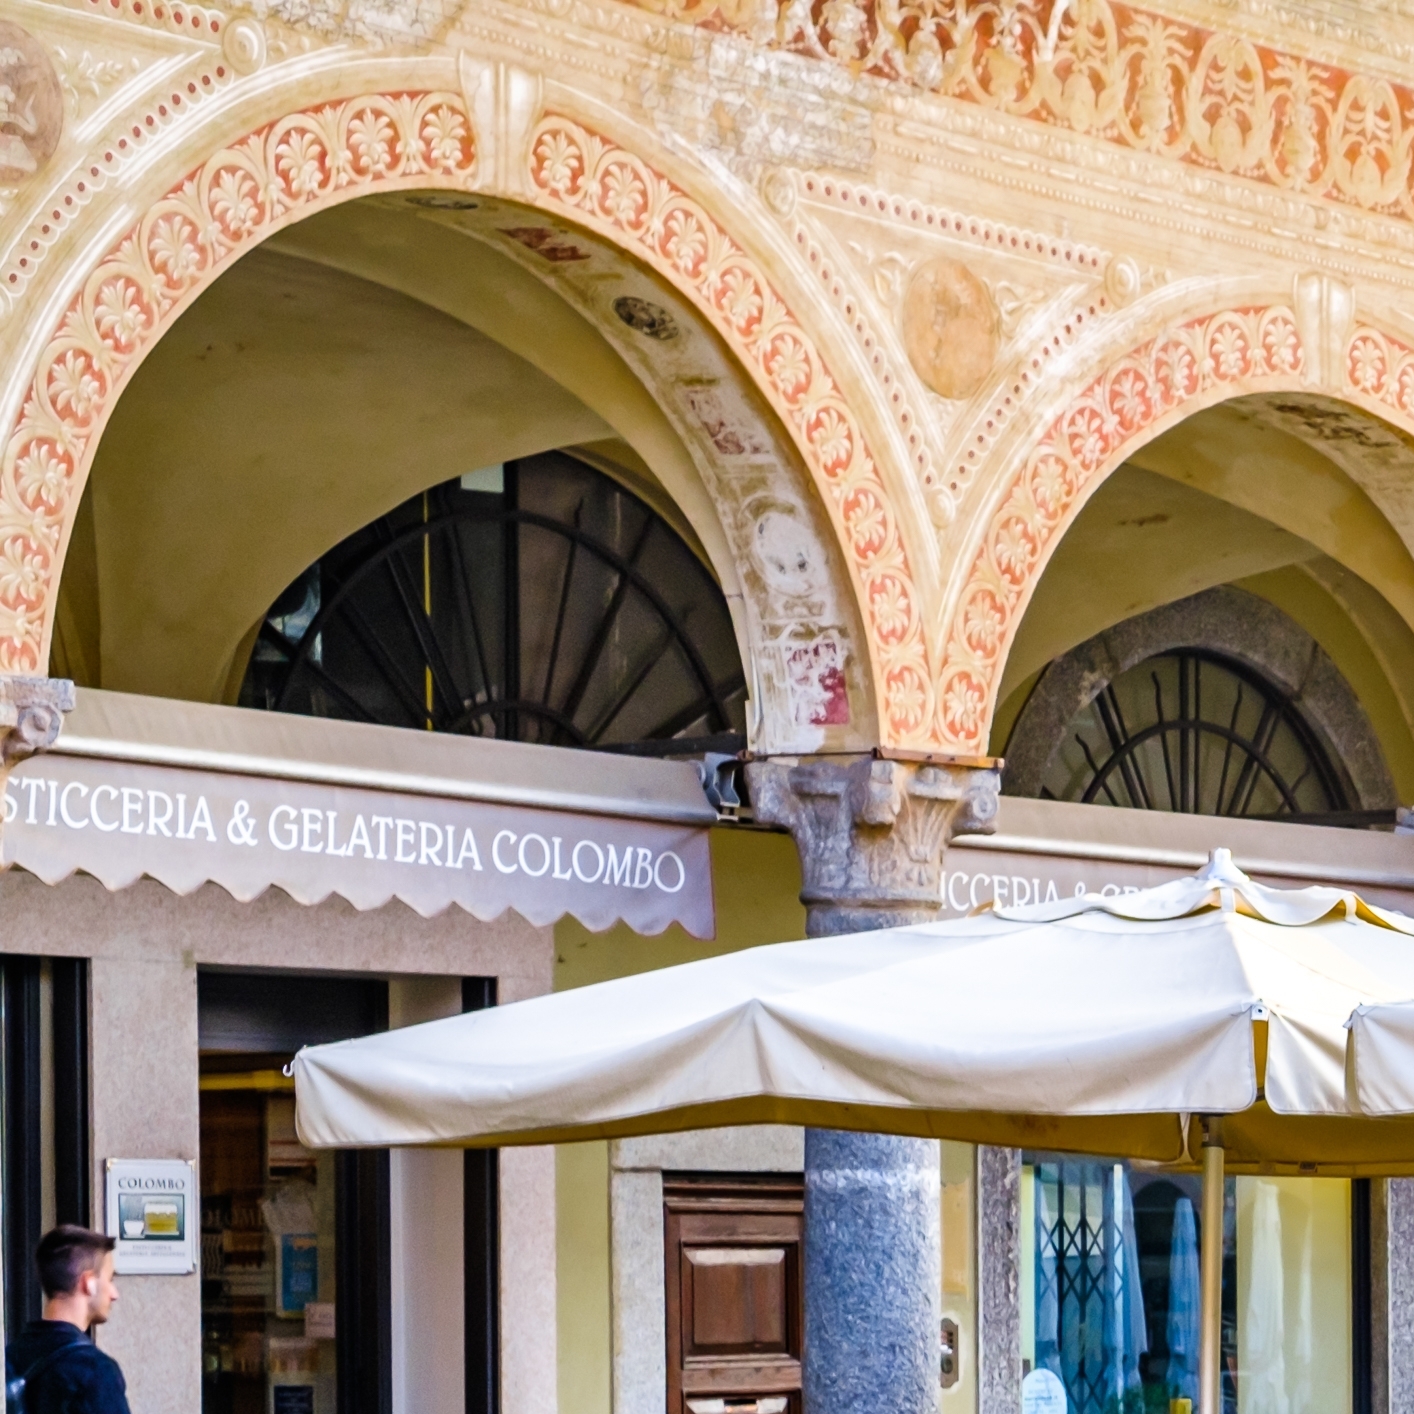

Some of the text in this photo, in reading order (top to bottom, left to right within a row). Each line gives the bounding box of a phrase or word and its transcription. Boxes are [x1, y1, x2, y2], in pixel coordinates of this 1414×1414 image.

[226, 799, 258, 846] &
[268, 804, 483, 871] GELATERIA
[491, 830, 685, 893] COLOMBO
[118, 1177, 185, 1190] COLOMBO
